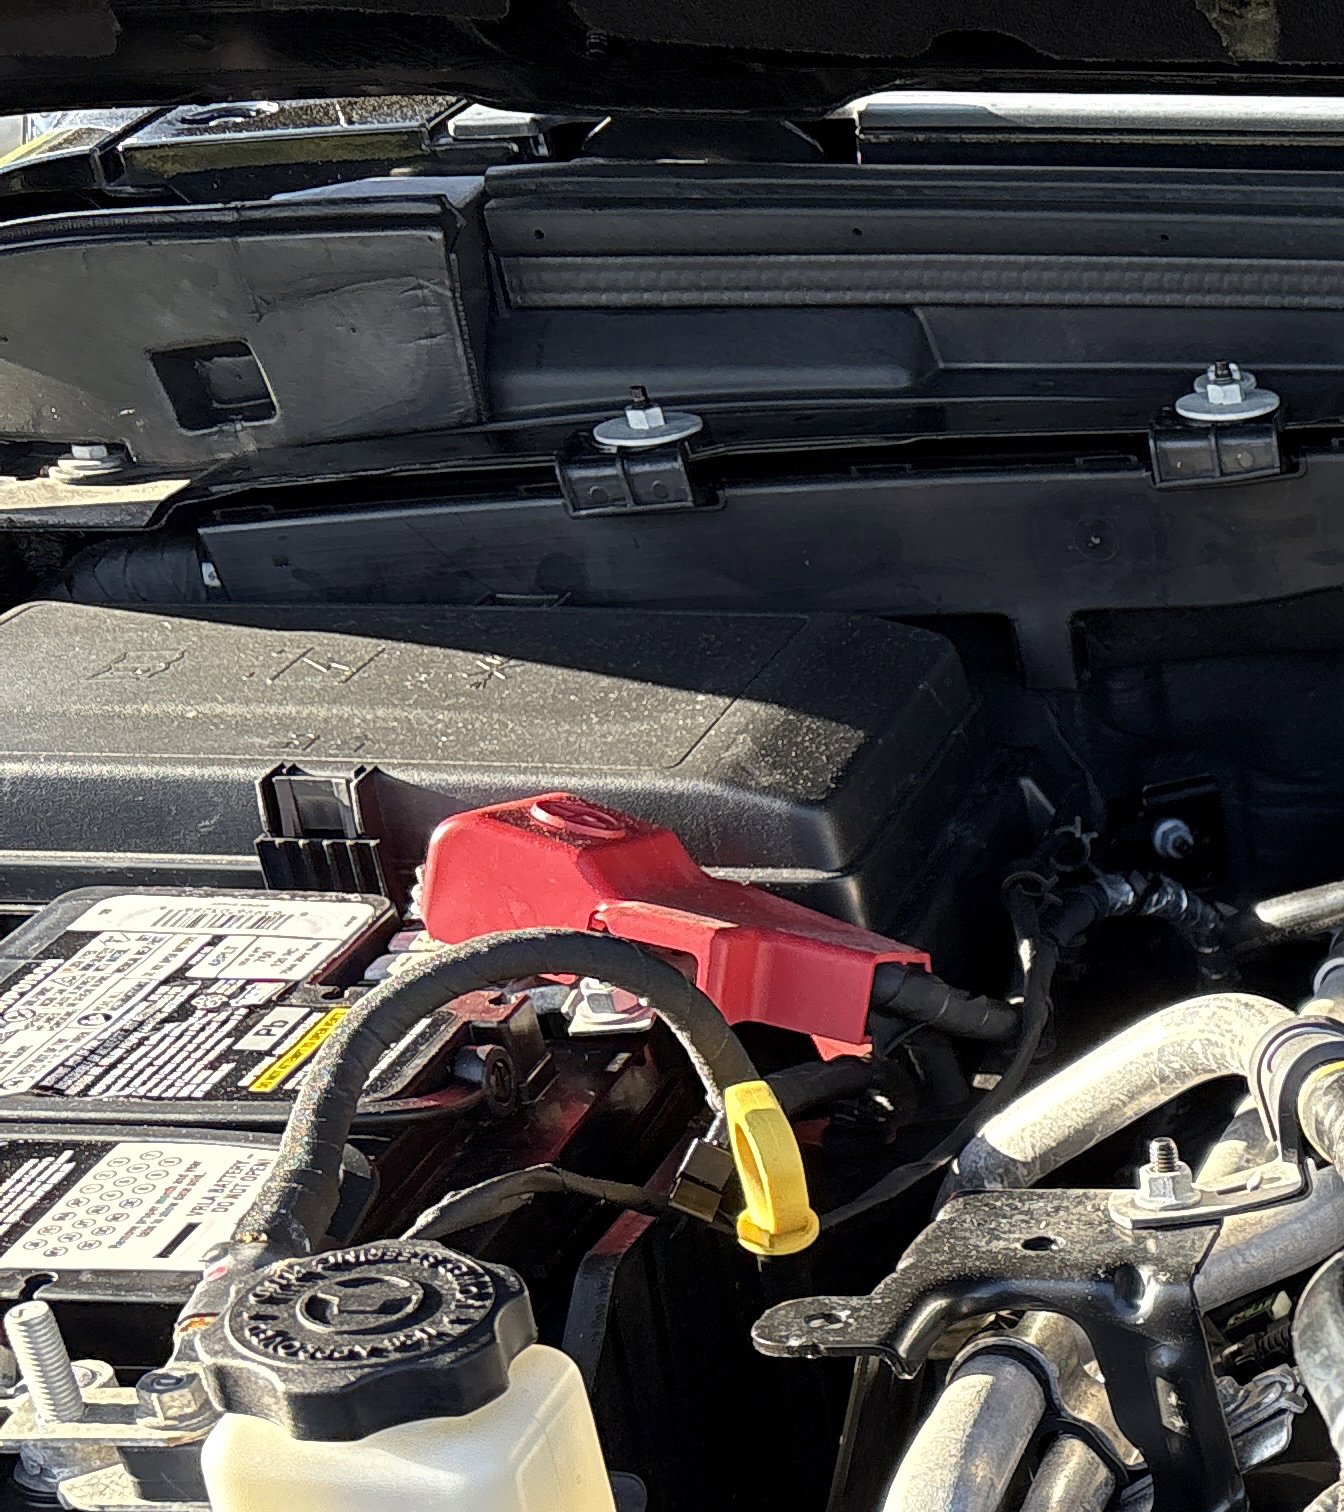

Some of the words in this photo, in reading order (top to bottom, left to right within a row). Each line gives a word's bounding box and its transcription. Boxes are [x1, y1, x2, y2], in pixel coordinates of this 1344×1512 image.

[252, 1019, 290, 1038] Pb
[185, 1195, 220, 1216] VRLA
[206, 1159, 250, 1193] BATTERY
[209, 1201, 235, 1213] DO
[222, 1182, 251, 1199] NOT
[241, 1158, 273, 1181] OPEN!
